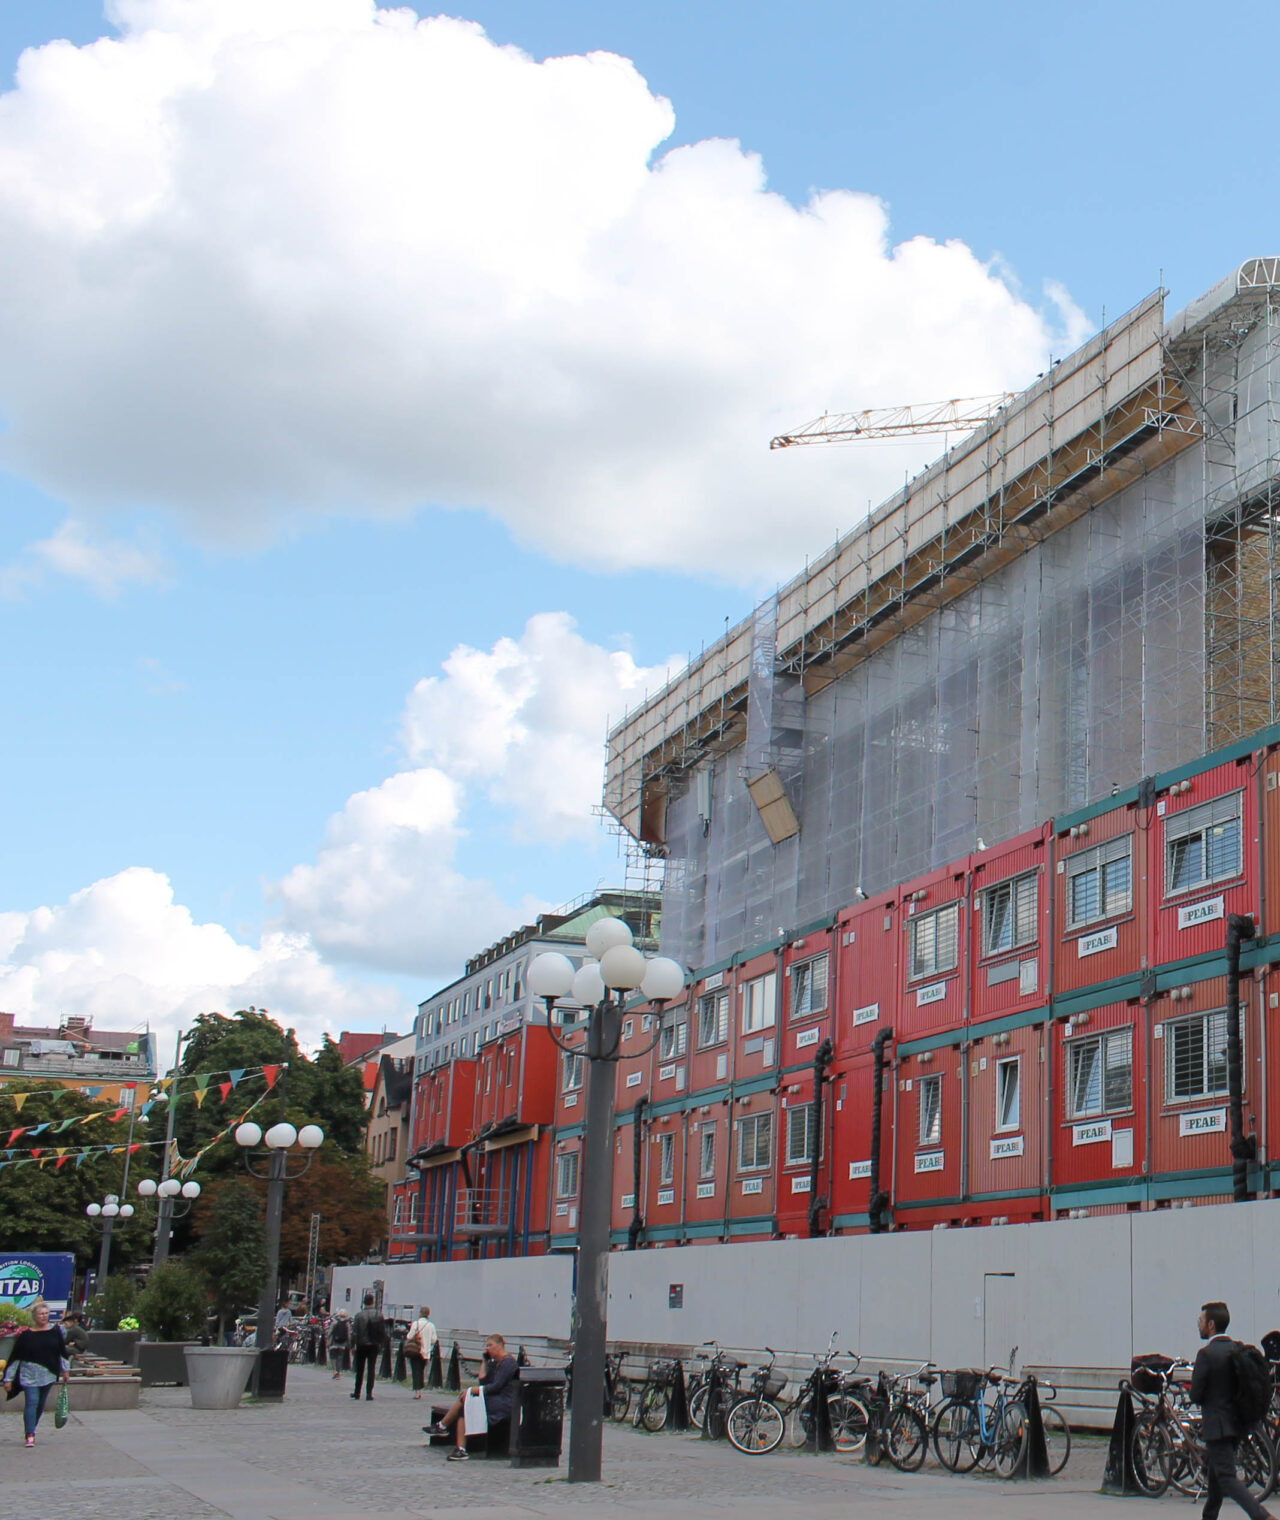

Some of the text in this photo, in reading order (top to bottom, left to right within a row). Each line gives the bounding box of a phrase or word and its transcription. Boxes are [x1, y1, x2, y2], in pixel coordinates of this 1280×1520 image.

[1187, 905, 1214, 921] PEAB
[1086, 935, 1109, 950] PEAB
[1189, 1116, 1217, 1129] PEAB
[1080, 1127, 1103, 1140] PEAB
[996, 1142, 1016, 1153] PEAB
[918, 1158, 939, 1169] PEAB
